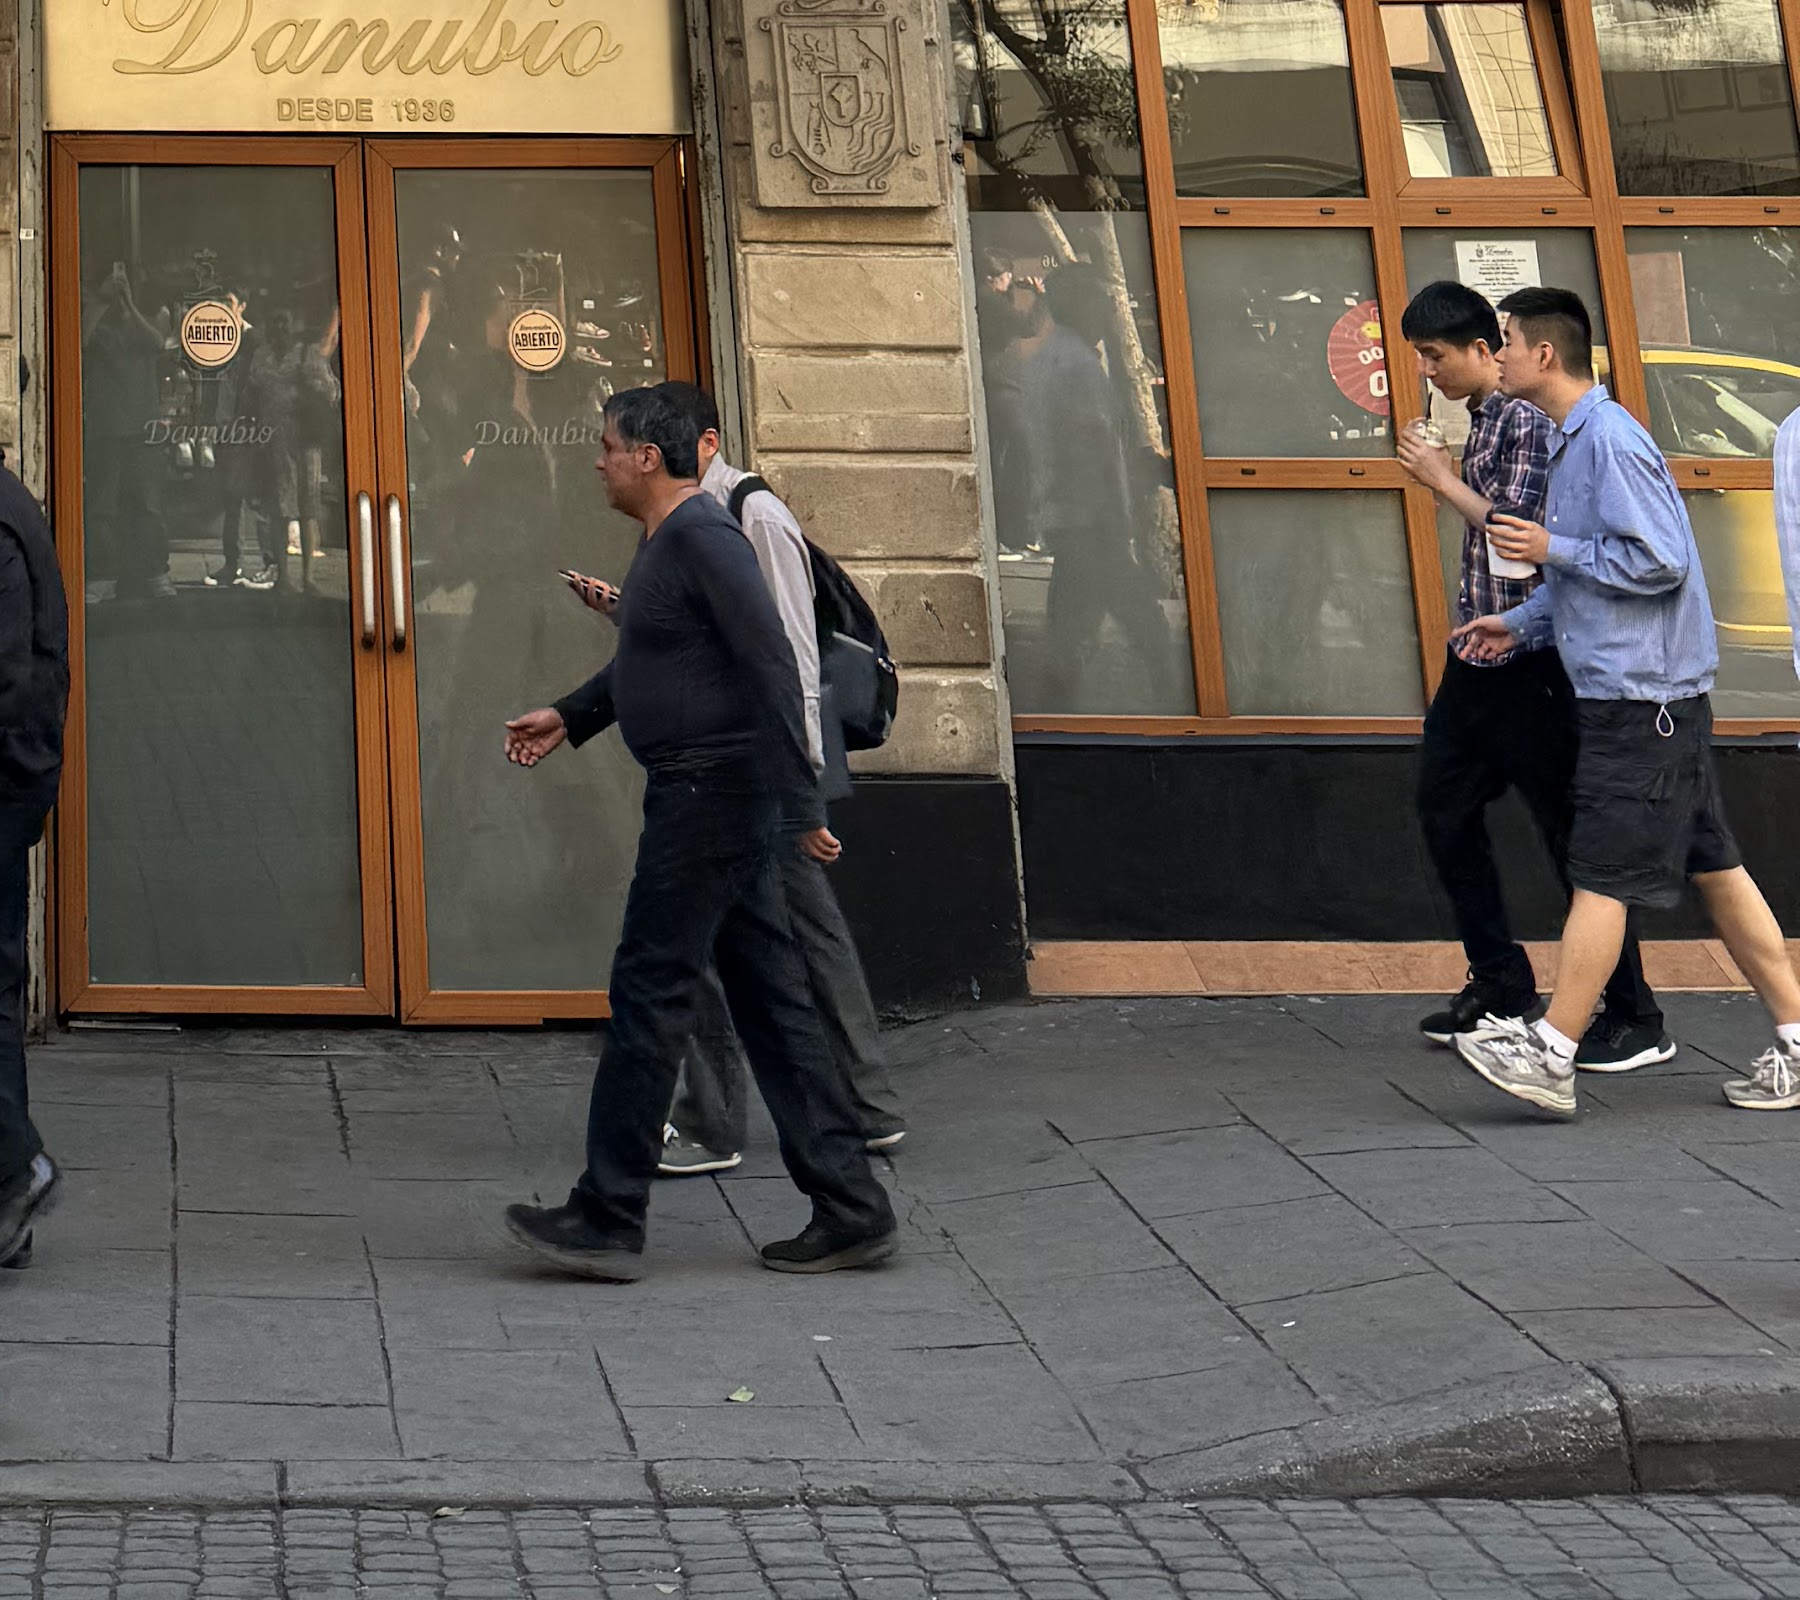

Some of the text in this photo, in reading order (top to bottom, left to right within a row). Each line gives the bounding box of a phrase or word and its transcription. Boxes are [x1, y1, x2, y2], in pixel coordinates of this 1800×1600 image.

[276, 97, 456, 123] DESDE 1936
[187, 324, 235, 342] ABIERTO
[514, 331, 560, 348] ABIERTO
[143, 415, 276, 445] Danubio
